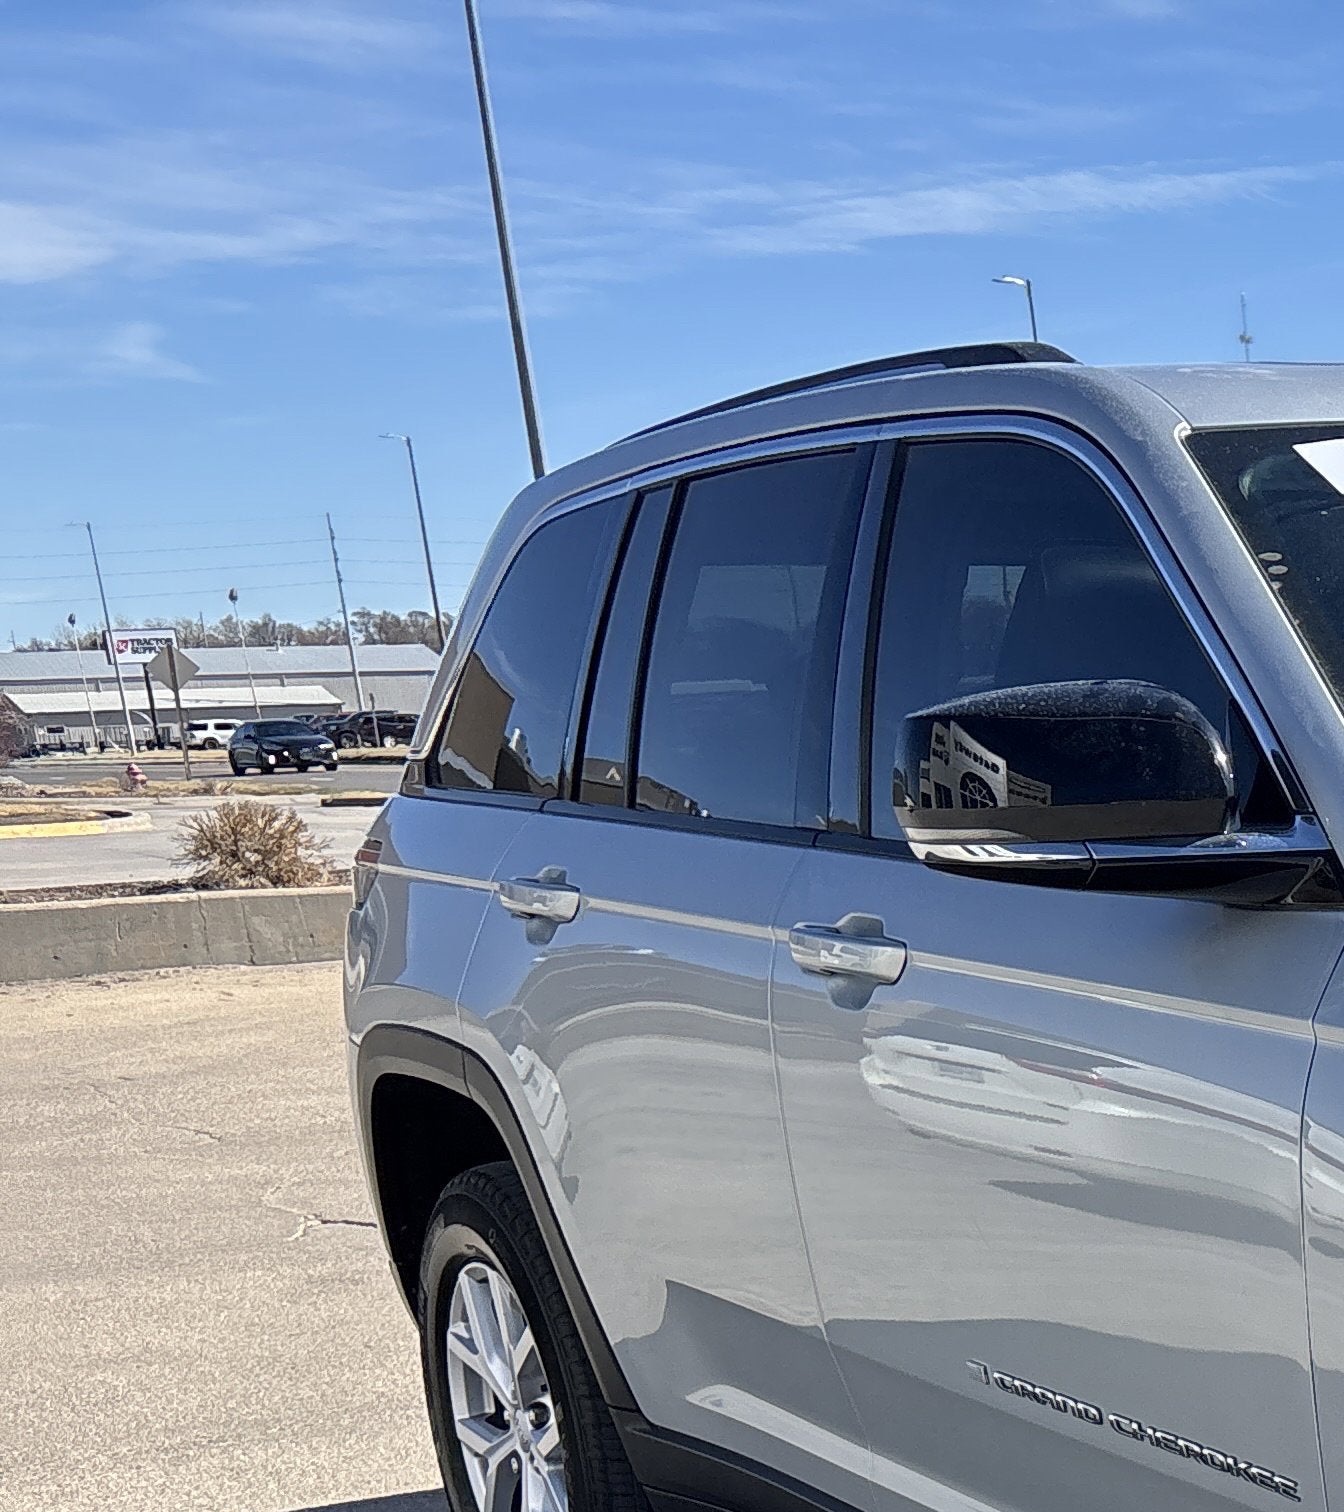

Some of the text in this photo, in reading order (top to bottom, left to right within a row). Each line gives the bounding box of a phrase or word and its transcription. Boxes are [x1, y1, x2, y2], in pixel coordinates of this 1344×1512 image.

[129, 637, 174, 646] TRACTOR
[992, 1370, 1302, 1503] GRAND CHEROKEE
